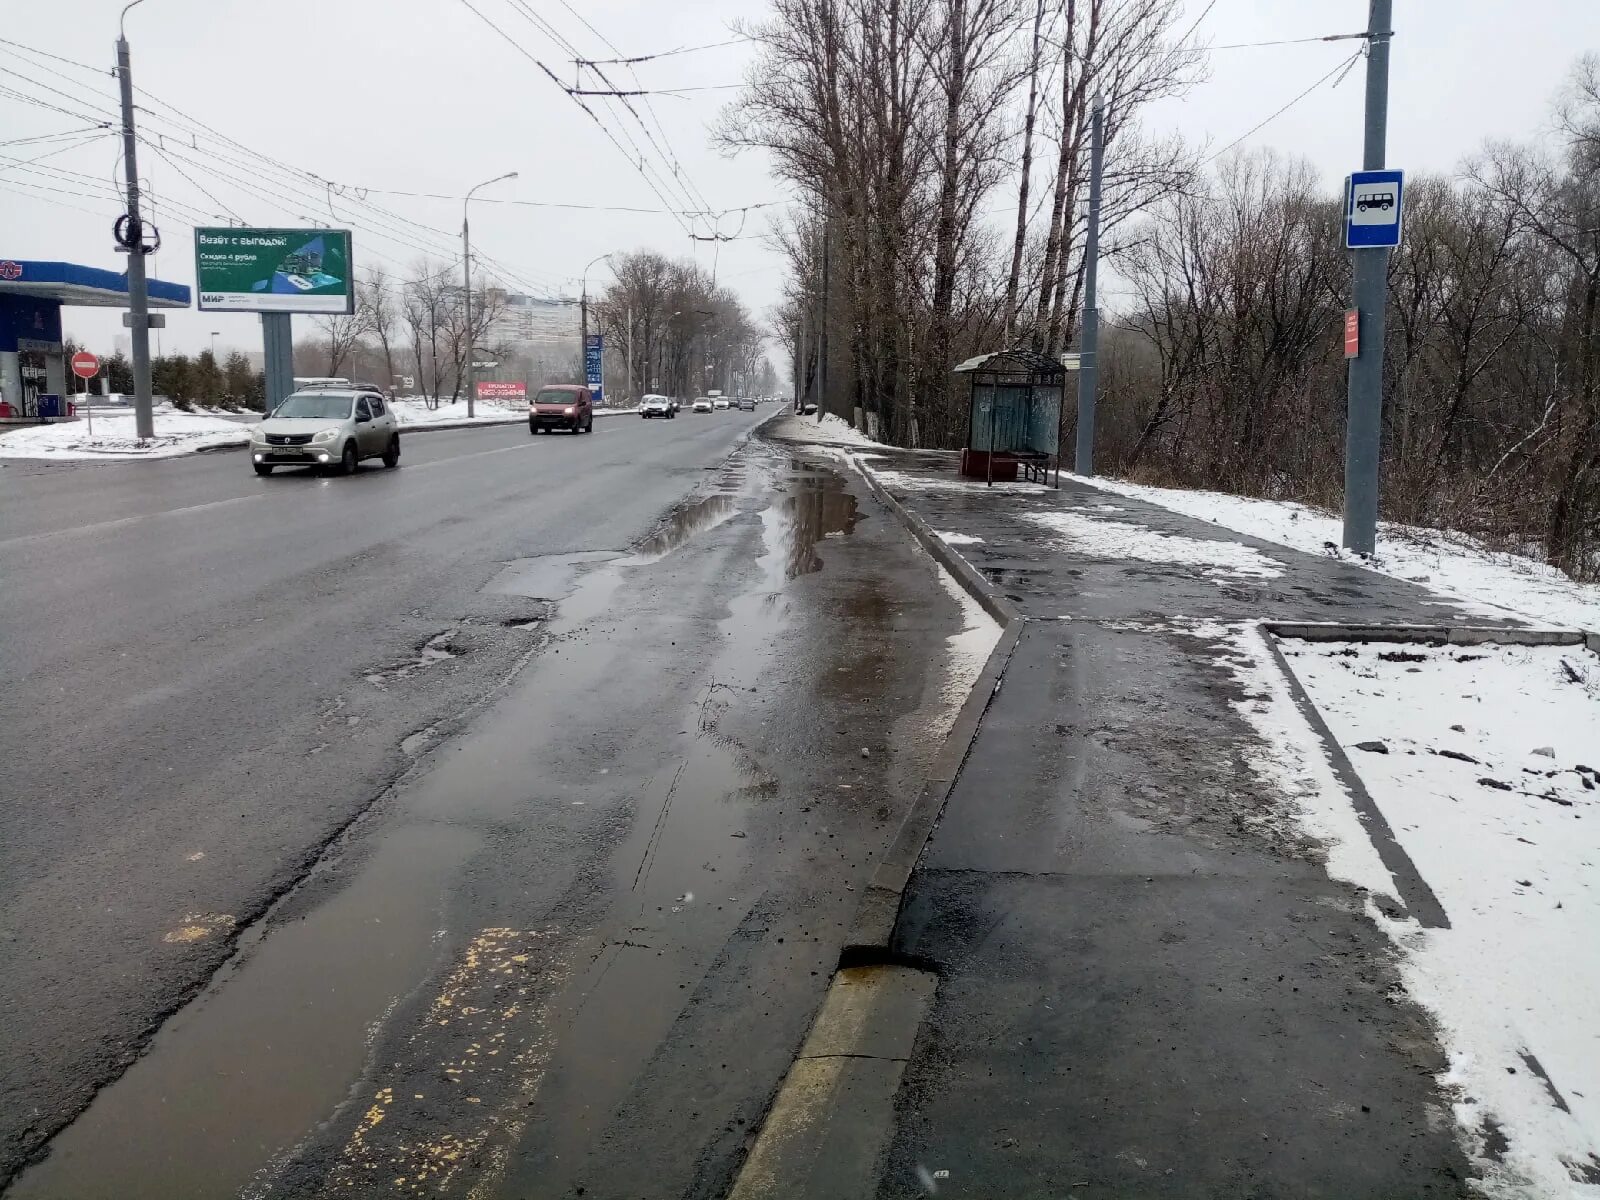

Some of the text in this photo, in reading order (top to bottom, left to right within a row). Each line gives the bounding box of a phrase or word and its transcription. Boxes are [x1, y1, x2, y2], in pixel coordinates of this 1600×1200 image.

[200, 235, 287, 246] Везёт с выгодой!
[200, 253, 227, 261] Скидка
[202, 295, 225, 303] МИР
